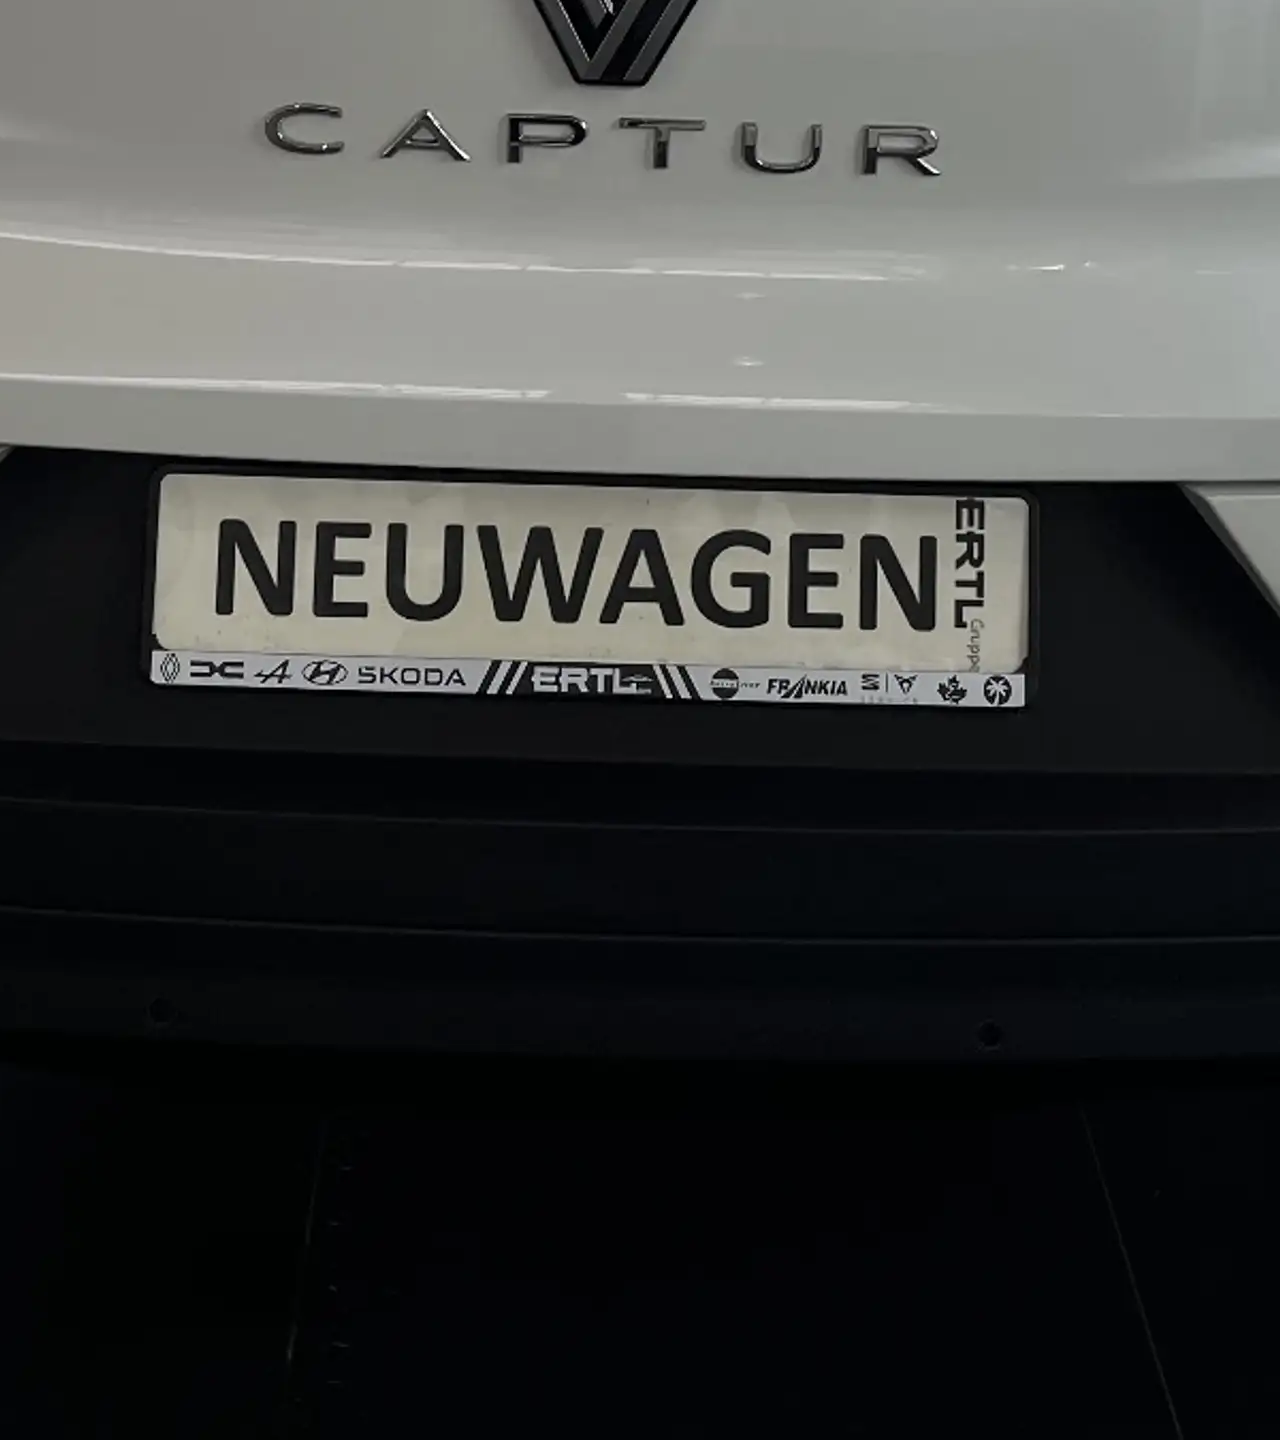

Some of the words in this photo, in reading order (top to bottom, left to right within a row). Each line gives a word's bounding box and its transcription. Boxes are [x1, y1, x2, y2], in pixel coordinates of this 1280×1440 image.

[264, 102, 942, 177] CAPTUR
[214, 517, 939, 633] NEUWAGEN
[954, 496, 985, 628] ERTL
[531, 666, 637, 694] ERTL
[766, 674, 848, 699] FRANKIA
